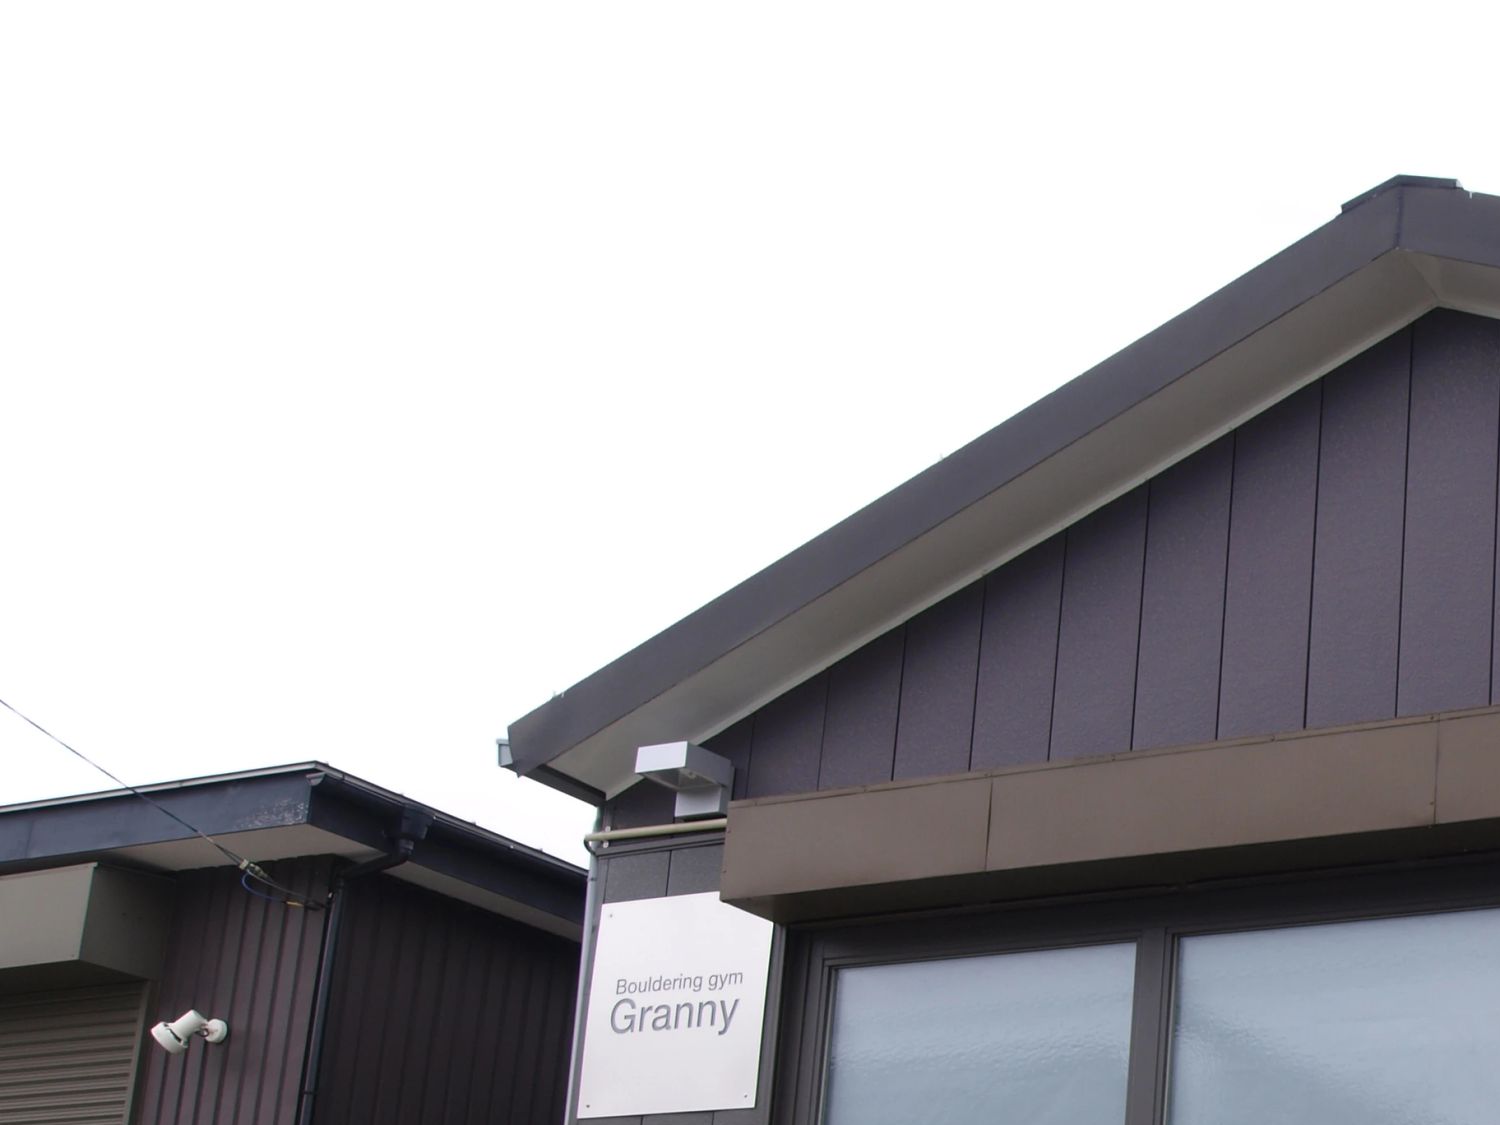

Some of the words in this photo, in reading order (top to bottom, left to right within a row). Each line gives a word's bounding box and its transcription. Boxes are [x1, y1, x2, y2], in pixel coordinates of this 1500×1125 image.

[616, 973, 703, 995] Bouldering
[708, 972, 744, 991] gym
[610, 998, 741, 1036] Granny
